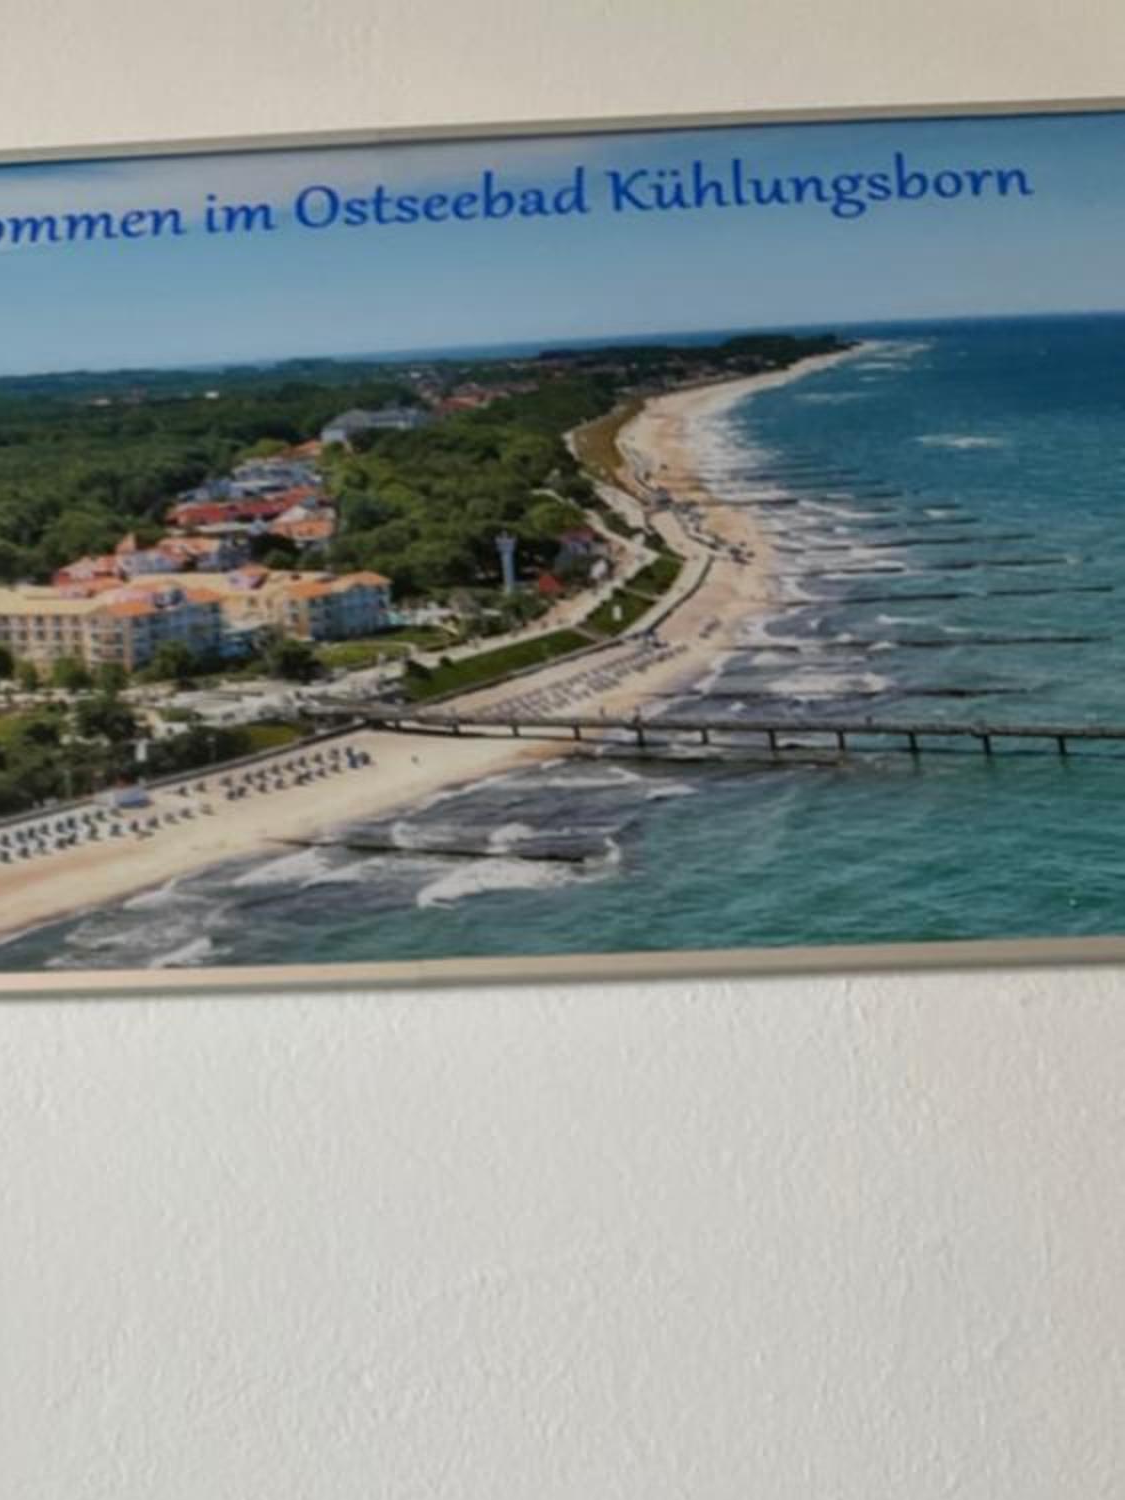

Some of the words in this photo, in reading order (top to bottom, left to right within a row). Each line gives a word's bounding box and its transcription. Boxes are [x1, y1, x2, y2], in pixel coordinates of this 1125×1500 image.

[205, 203, 276, 234] im
[294, 172, 587, 229] Ostseebad
[607, 153, 1031, 218] Kühlungsborn
